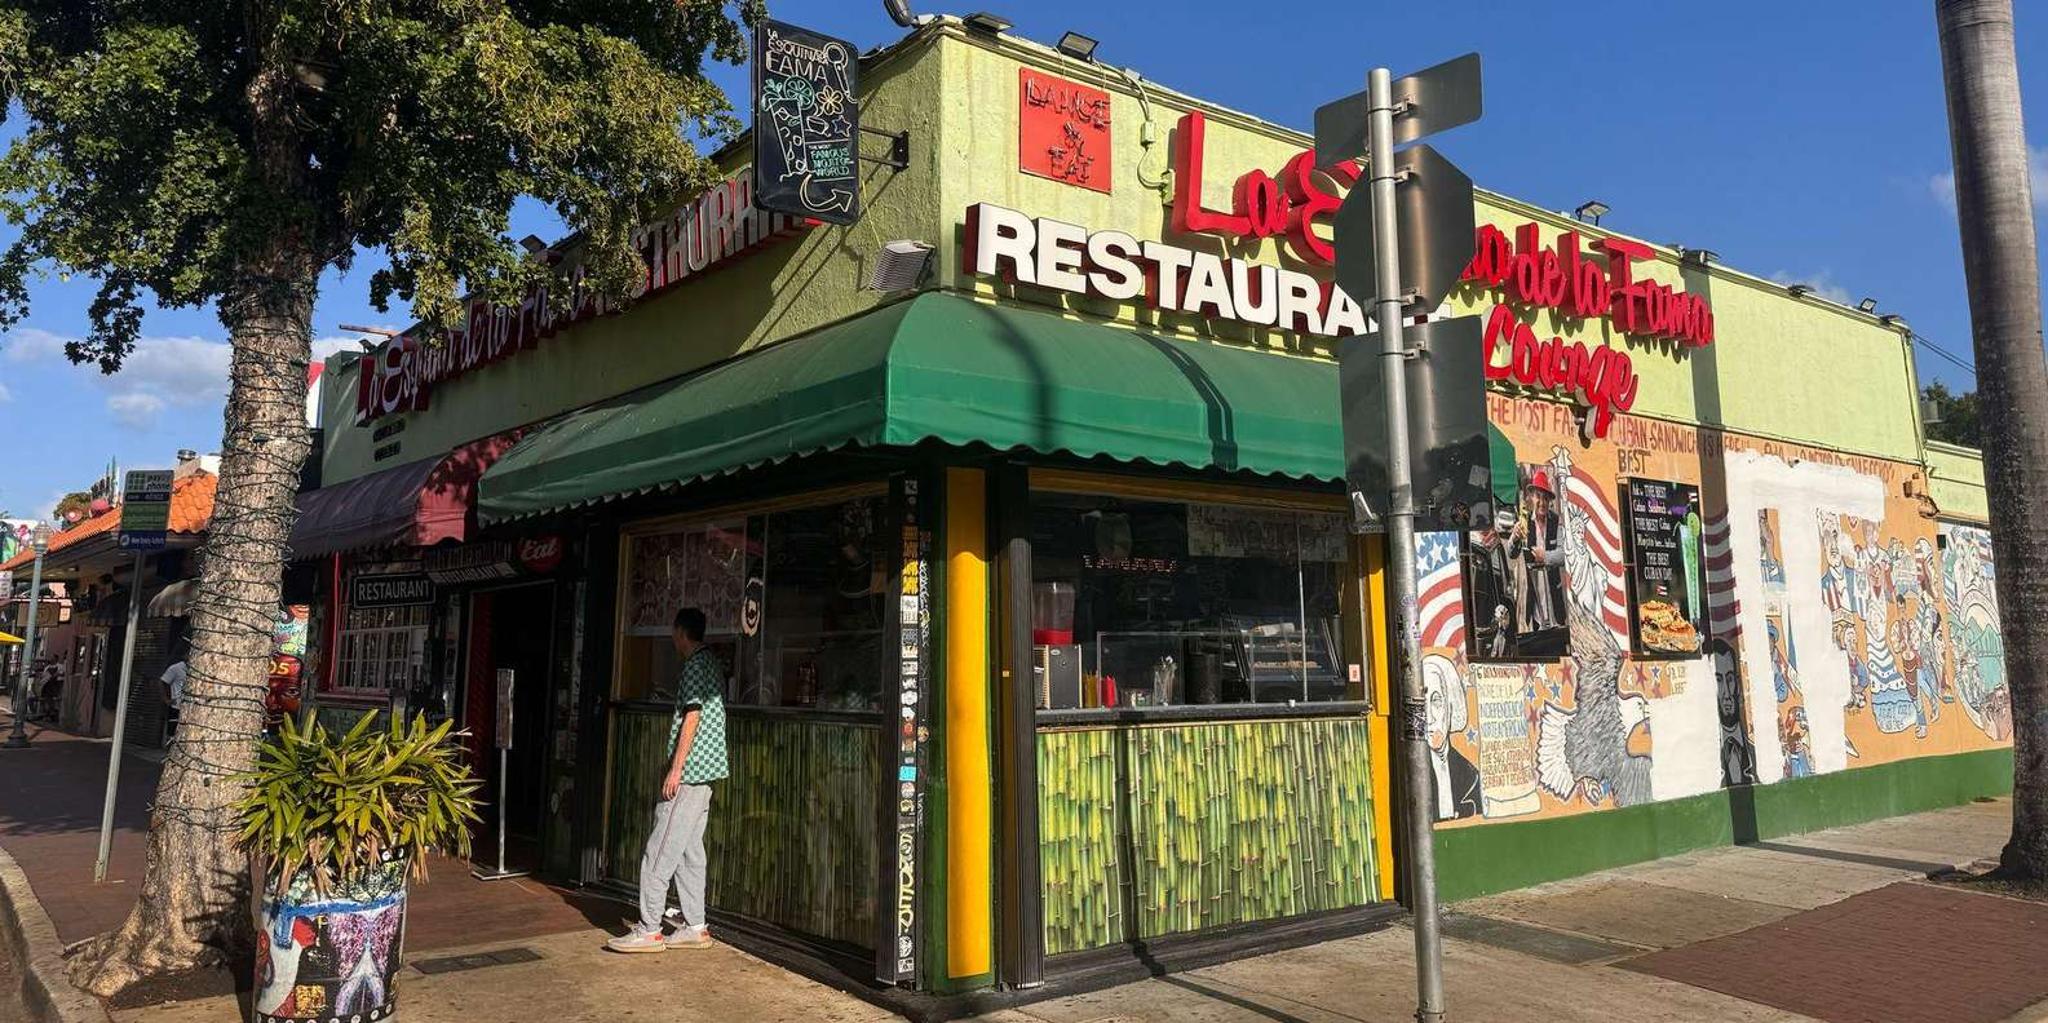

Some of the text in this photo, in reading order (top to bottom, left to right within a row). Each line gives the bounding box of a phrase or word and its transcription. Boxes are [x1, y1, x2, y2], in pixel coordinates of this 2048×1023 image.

[766, 50, 829, 85] FAMA
[810, 147, 850, 160] FAMOUS
[977, 200, 1452, 338] RESTAURA
[1170, 109, 1290, 241] La
[1516, 222, 1568, 307] de
[1590, 236, 1715, 350] Fama
[1483, 303, 1638, 438] Lounge
[358, 581, 431, 601] RESTAURANT
